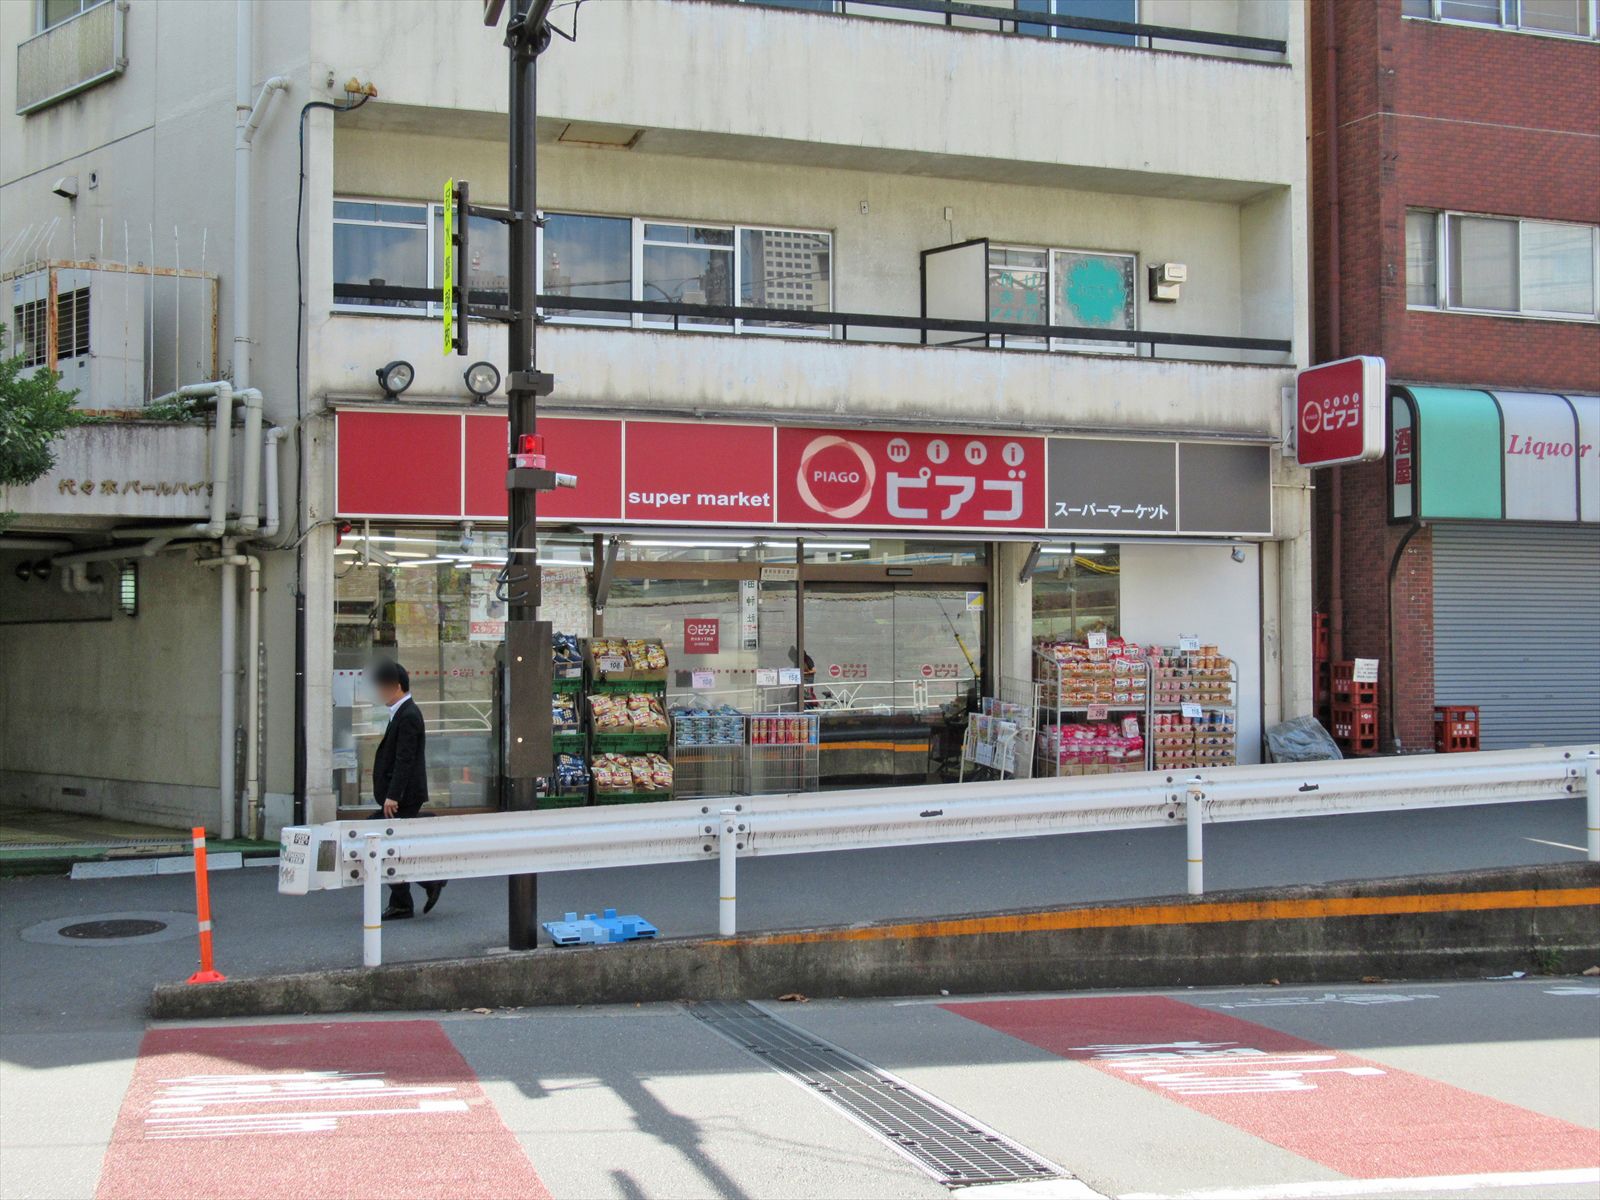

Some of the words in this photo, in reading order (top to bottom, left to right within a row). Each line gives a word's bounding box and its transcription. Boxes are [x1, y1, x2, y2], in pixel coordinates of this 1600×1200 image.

[1323, 403, 1360, 431] ピアゴ
[888, 440, 1022, 467] mini
[1394, 426, 1412, 485] 酒屋
[1506, 434, 1592, 460] Liquor
[813, 470, 860, 484] PIAGO
[628, 492, 691, 508] super
[697, 491, 770, 508] market
[886, 467, 1027, 521] ピアゴ
[1054, 501, 1170, 521] スーパーマーケット
[842, 668, 867, 678] ピアゴ
[934, 668, 959, 678] ピアゴ
